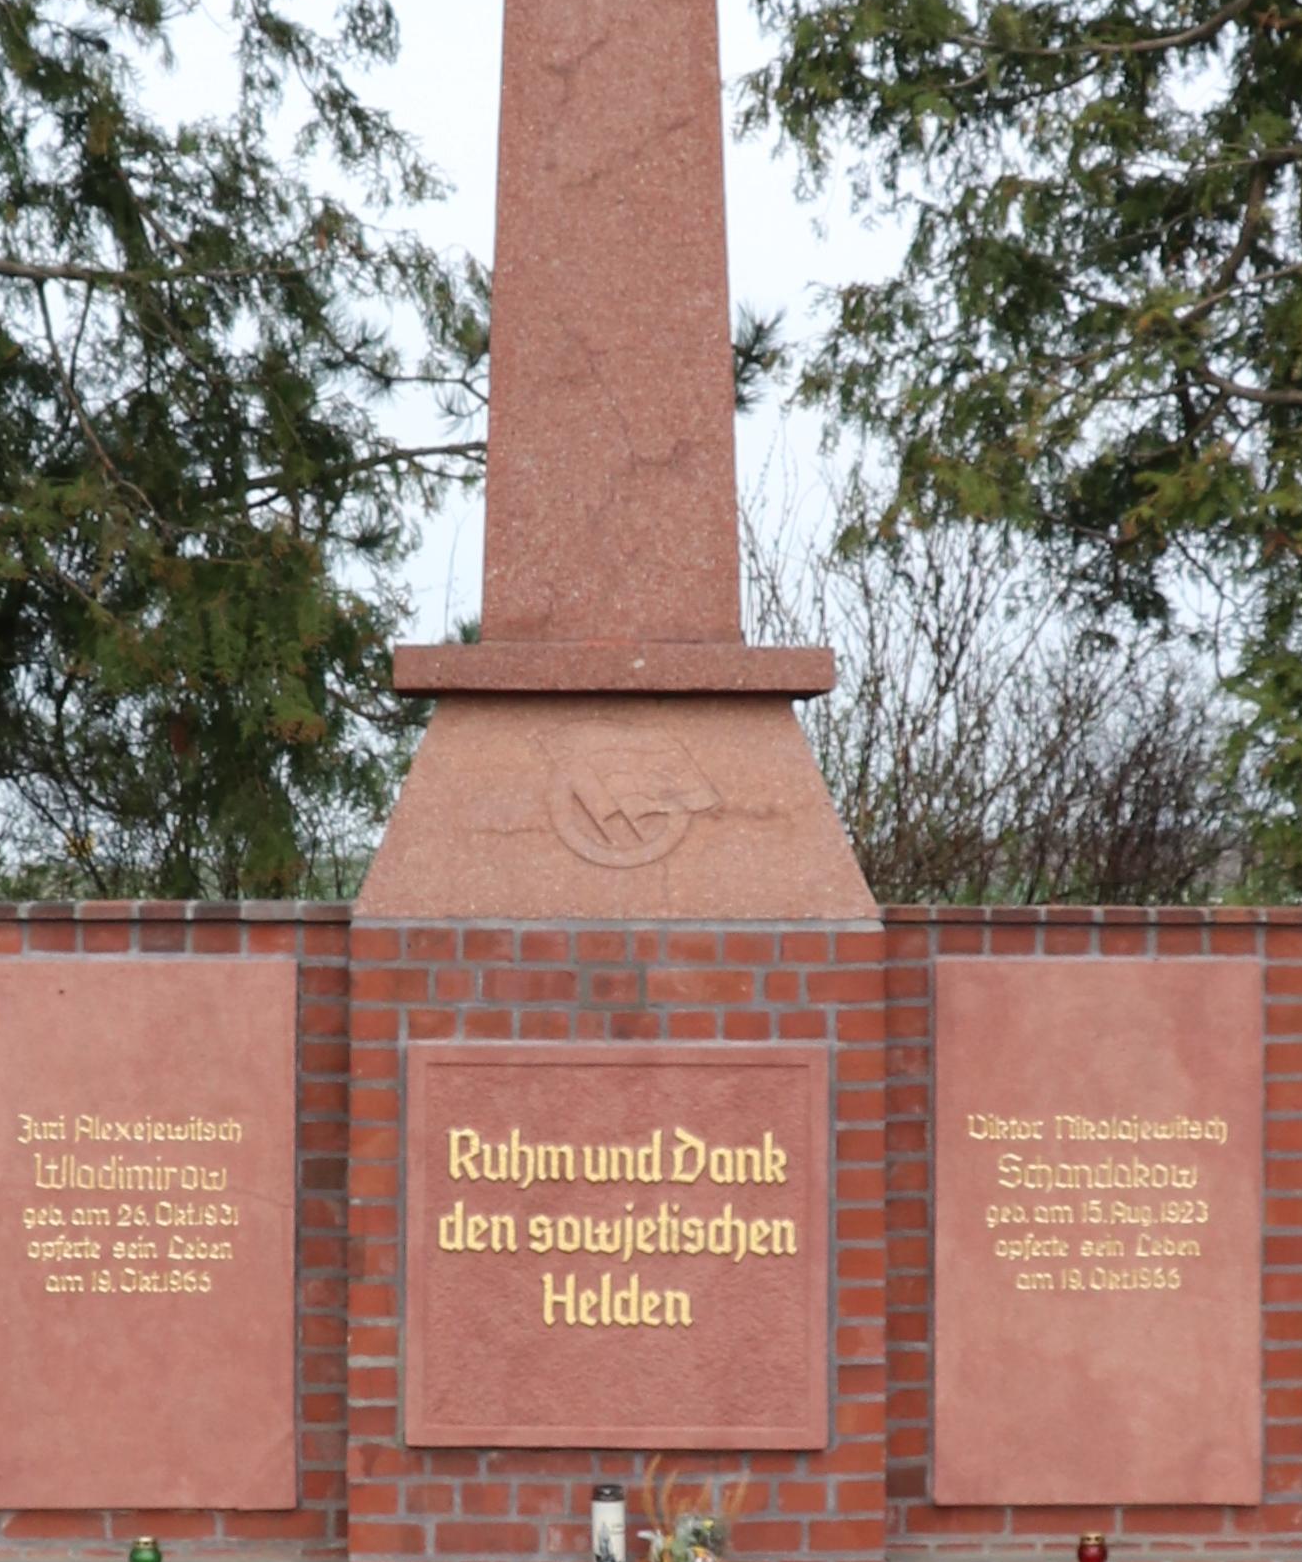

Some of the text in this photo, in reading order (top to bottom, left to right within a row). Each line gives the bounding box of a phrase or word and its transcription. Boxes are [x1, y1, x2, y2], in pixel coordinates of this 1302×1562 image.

[17, 1113, 242, 1144] Juri Alexejewitsch
[967, 1113, 1229, 1145] Viktor Nikolajewitsch
[33, 1152, 227, 1191] Wladimirow
[448, 1126, 788, 1189] Ruhm und Dank
[998, 1152, 1198, 1193] Schandakow
[71, 1207, 111, 1226] am
[1033, 1205, 1075, 1224] am
[27, 1234, 233, 1261] opferte sein Leben
[438, 1200, 798, 1264] den sowjetischen
[994, 1233, 1201, 1261] opferte sein Leben
[45, 1274, 84, 1293] am
[1016, 1271, 1054, 1290] am
[541, 1272, 693, 1328] Helden
